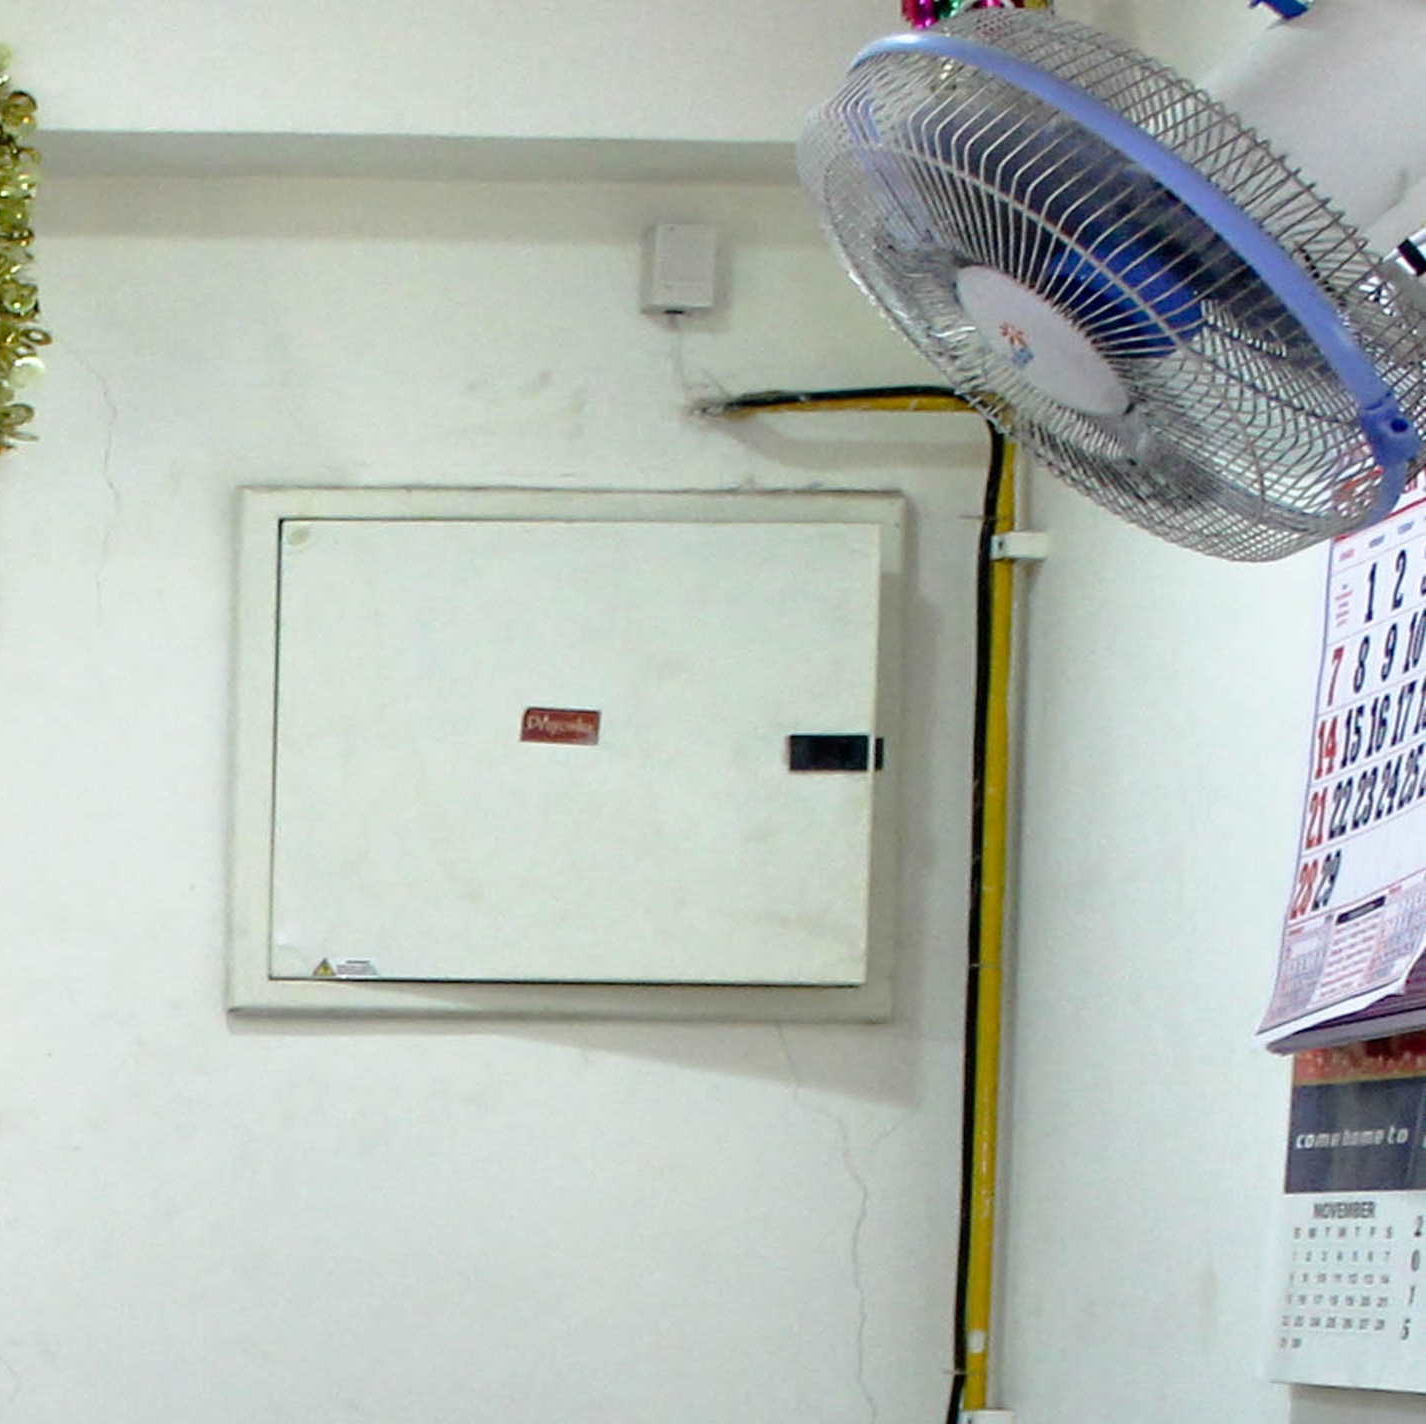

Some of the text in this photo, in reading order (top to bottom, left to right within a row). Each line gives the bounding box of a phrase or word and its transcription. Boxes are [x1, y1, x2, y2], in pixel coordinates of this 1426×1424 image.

[1364, 562, 1377, 624] 1
[1392, 549, 1407, 610] 2
[1326, 646, 1344, 707] 7
[1353, 635, 1370, 694] 8
[1381, 622, 1397, 682] 9
[1315, 716, 1338, 780] 14
[1340, 705, 1364, 769] 15
[1365, 692, 1390, 758] 16
[1391, 680, 1418, 747] 17
[1306, 787, 1328, 849] 21
[1328, 776, 1353, 840] 22
[1351, 766, 1378, 830] 23
[1374, 754, 1403, 821] 24
[1387, 1126, 1409, 1144] to
[1313, 1201, 1376, 1218] NOVEMBER
